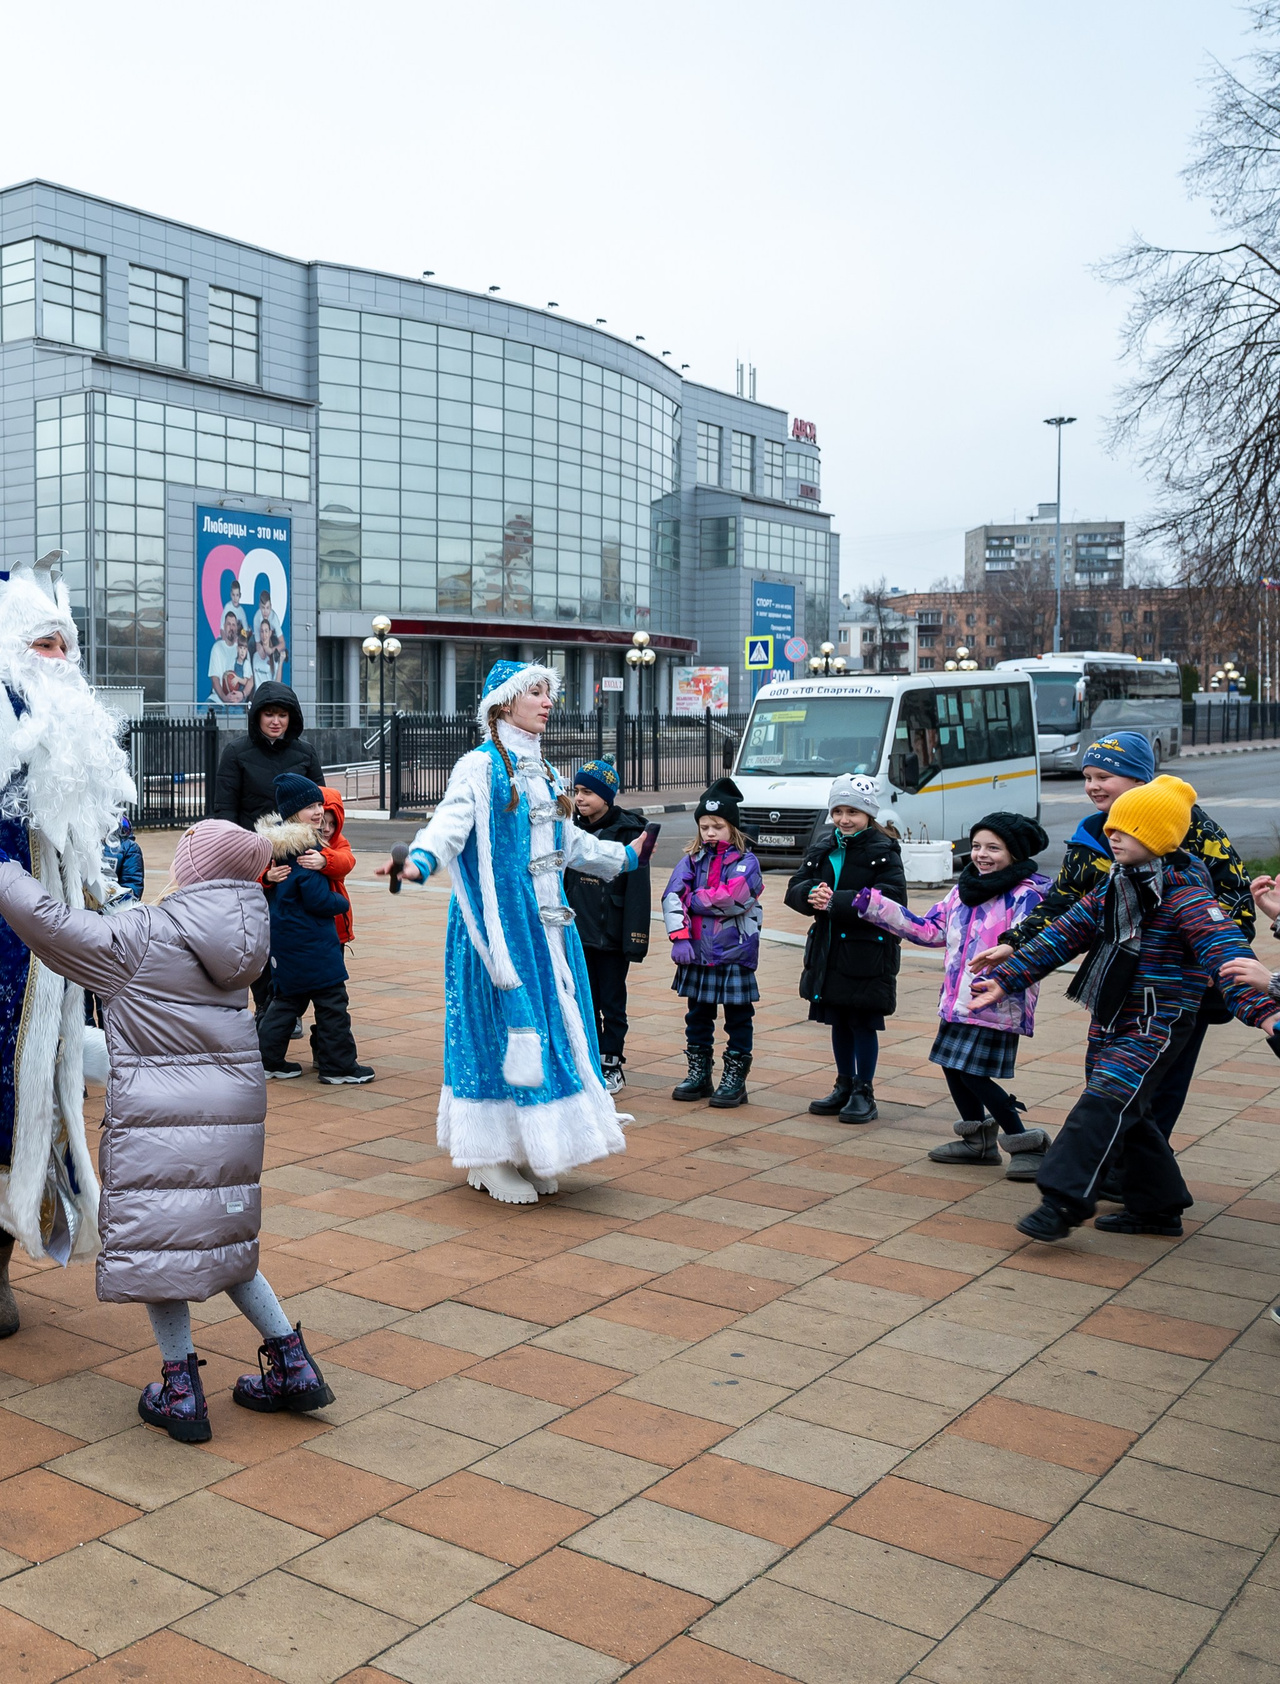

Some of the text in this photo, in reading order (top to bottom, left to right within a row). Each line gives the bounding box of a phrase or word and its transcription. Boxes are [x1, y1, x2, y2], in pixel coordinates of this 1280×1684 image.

[203, 516, 247, 538] Люберцы
[257, 526, 271, 539] это
[273, 529, 287, 541] мы
[756, 597, 772, 607] СПОРТ
[817, 686, 862, 695] Спартак
